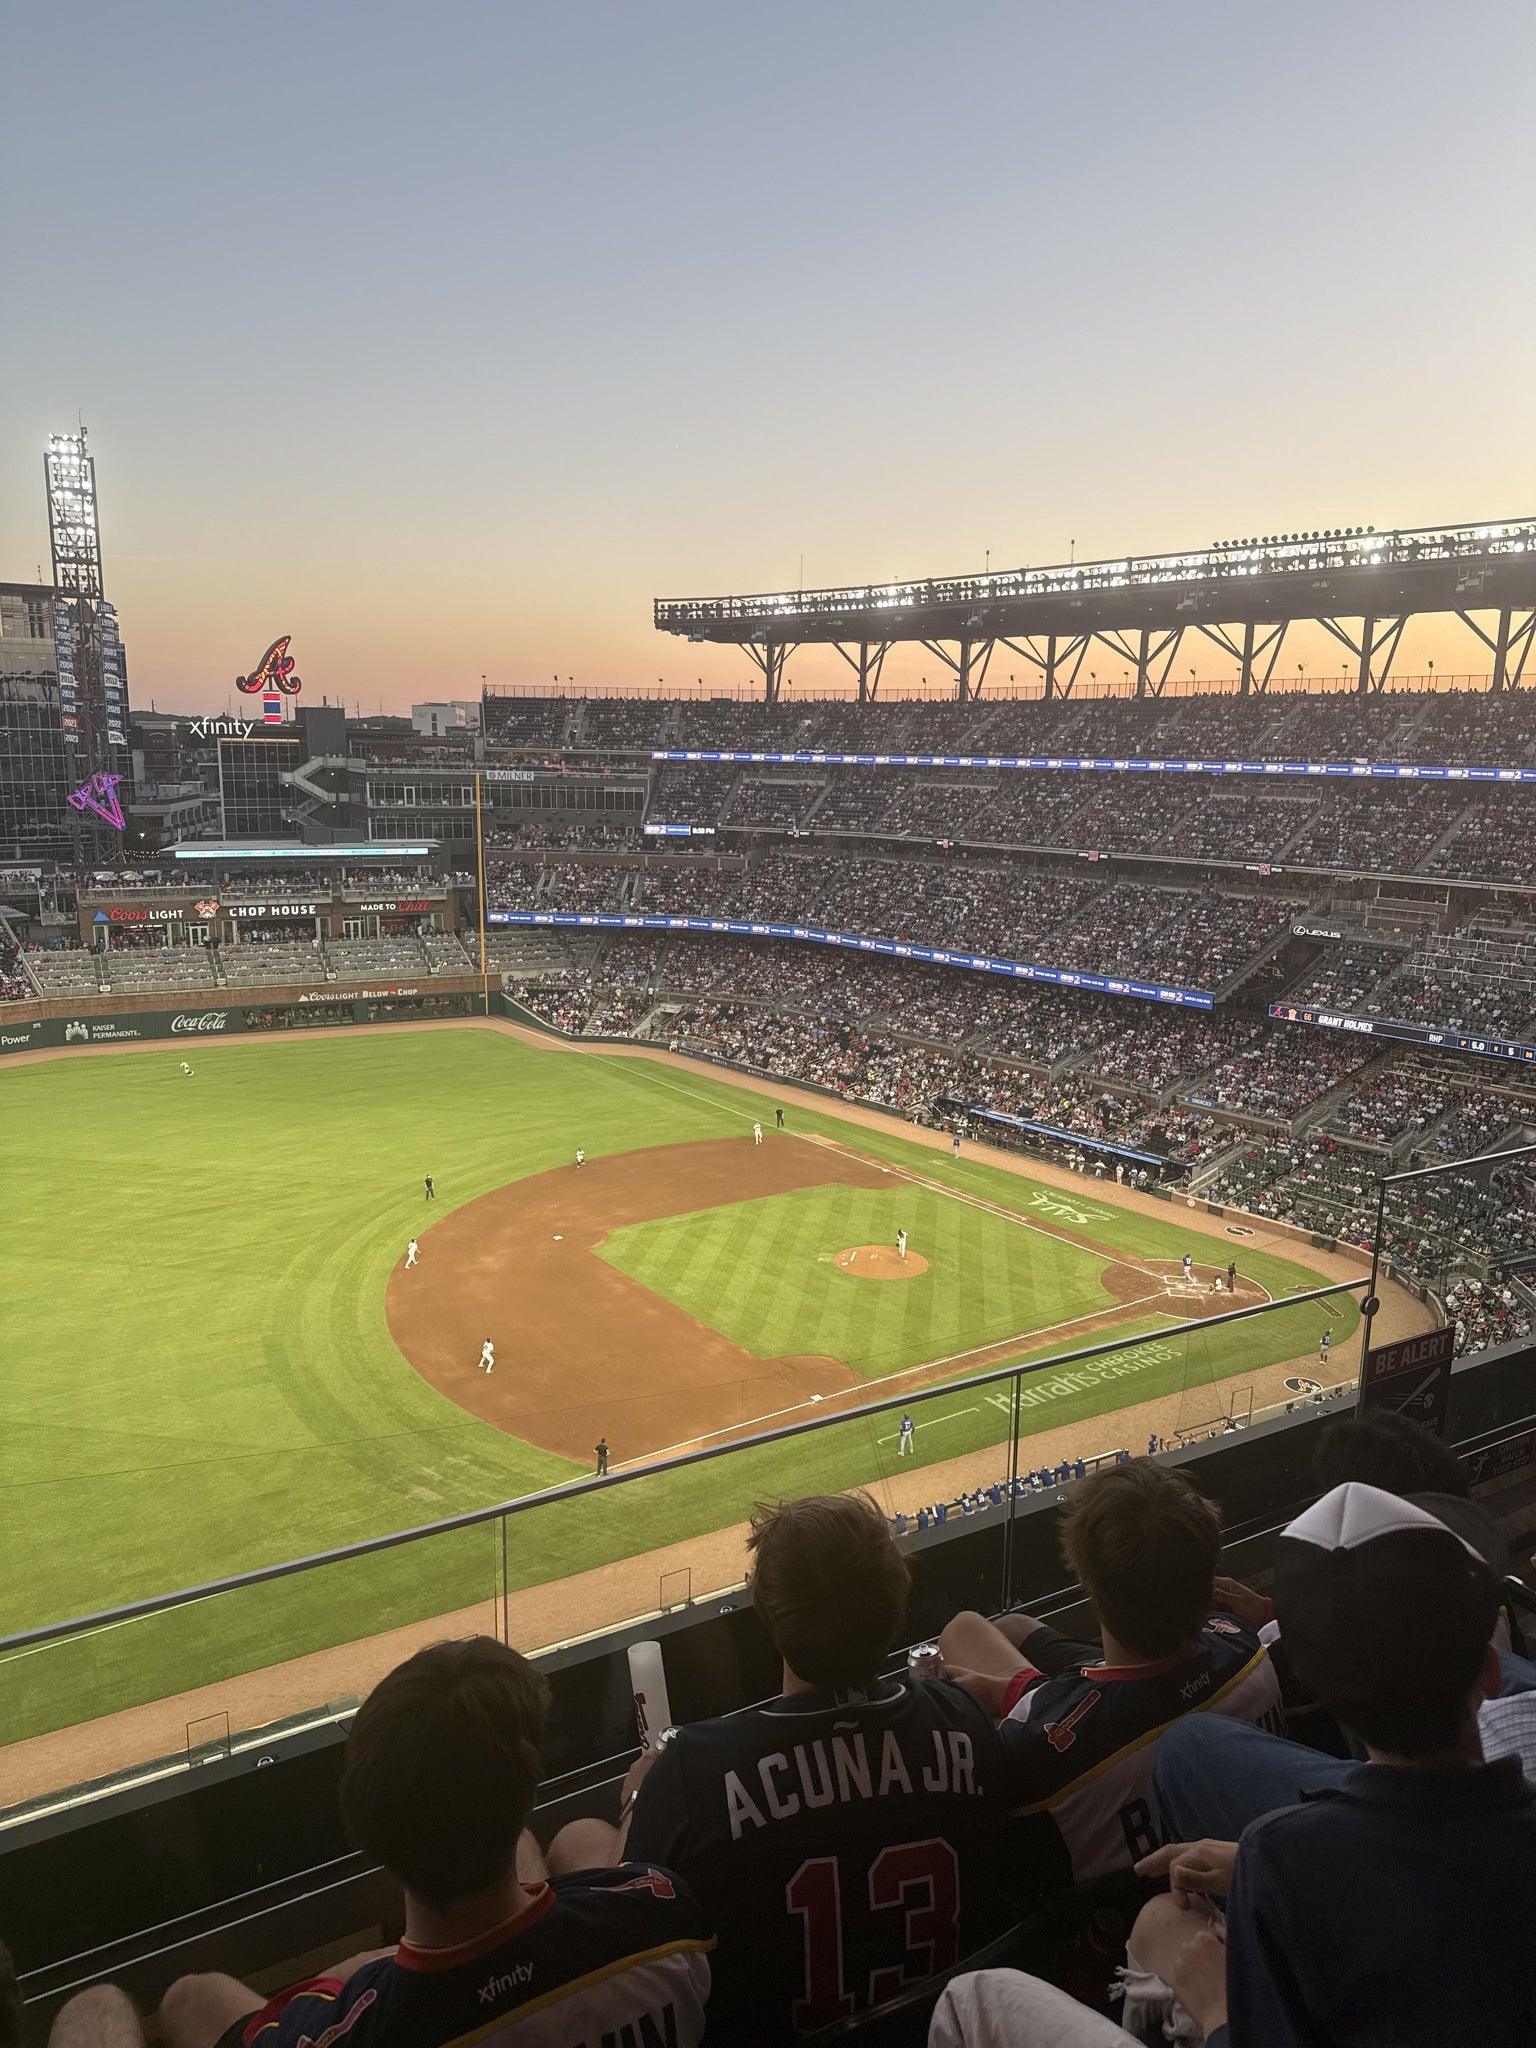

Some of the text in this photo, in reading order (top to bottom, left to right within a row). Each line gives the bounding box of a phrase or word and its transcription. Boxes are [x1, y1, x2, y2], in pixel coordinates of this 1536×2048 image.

[101, 619, 114, 628] 1999
[57, 631, 71, 640] 2000
[102, 633, 115, 642] 2001
[58, 646, 72, 655] 2002
[103, 648, 117, 656] 2003
[60, 661, 74, 669] 2004
[104, 662, 118, 671] 2005
[61, 675, 74, 684] 2010
[61, 690, 75, 698] 2013
[63, 704, 76, 713] 2019
[107, 705, 120, 714] 2020
[64, 719, 77, 728] 2021
[108, 719, 121, 728] 2022
[189, 717, 254, 739] xfinity
[65, 734, 79, 743] 2023
[498, 771, 533, 780] MILNER
[706, 827, 715, 835] PM
[360, 899, 430, 912] MADE TO Chill
[109, 907, 184, 921] Coors LIGHT
[229, 905, 317, 917] CHOP HOUSE
[1306, 929, 1341, 938] LEXUS
[309, 988, 418, 1002] Coors LIGHT BELOW CHOP
[171, 1012, 229, 1033] Coca-Cola
[92, 1024, 115, 1032] KAISER
[1318, 1015, 1343, 1028] GRANT
[1343, 1019, 1374, 1032] HOLMES
[1429, 1033, 1443, 1043] RHP
[1, 1034, 31, 1046] Power
[1191, 1097, 1212, 1107] GEICO
[1085, 1342, 1168, 1372] CHEROKEE
[1375, 1334, 1449, 1375] BE ALERT
[1099, 1348, 1184, 1380] CASINOS
[1500, 1436, 1531, 1453] CAUTION
[1501, 1449, 1525, 1463] WATCH
[1493, 1455, 1530, 1476] YOUR STEP
[1178, 1671, 1211, 1700] xfinity
[724, 1721, 914, 1841] ACUÑA
[922, 1730, 984, 1796] JR.
[785, 1837, 961, 2034] 13
[477, 1961, 534, 2004] xfinity
